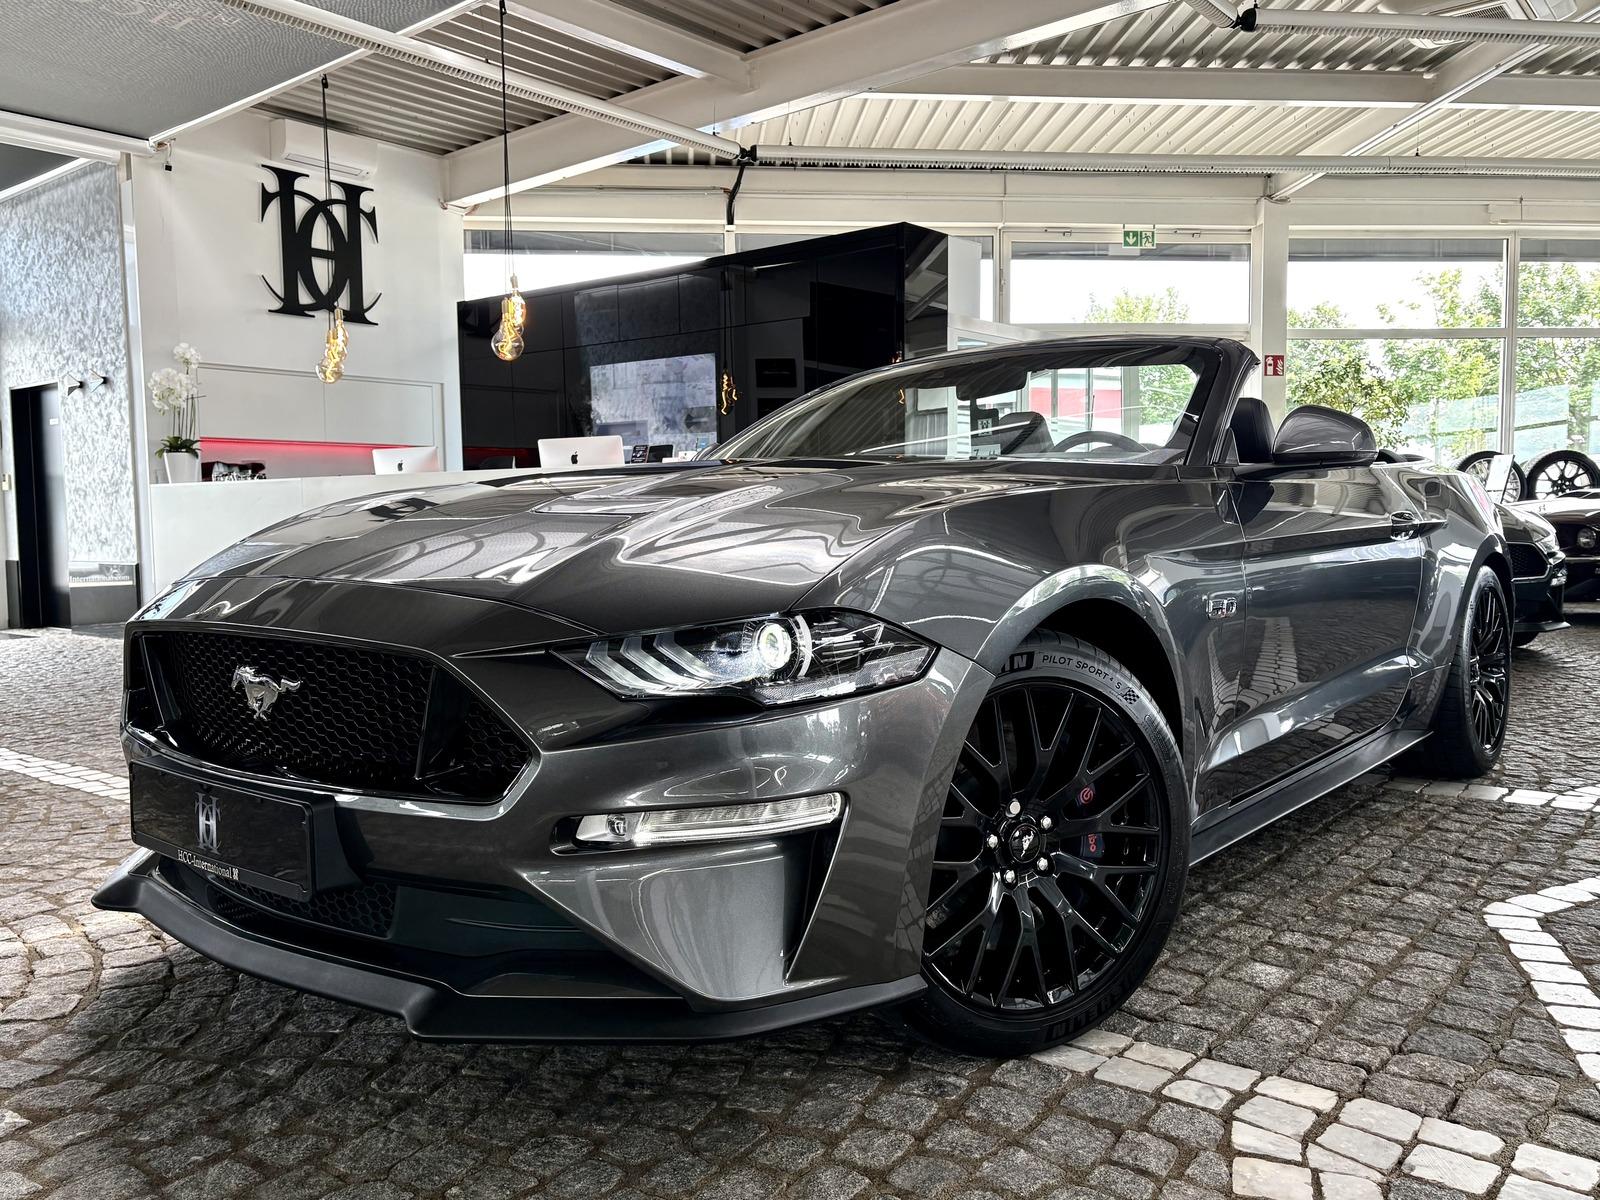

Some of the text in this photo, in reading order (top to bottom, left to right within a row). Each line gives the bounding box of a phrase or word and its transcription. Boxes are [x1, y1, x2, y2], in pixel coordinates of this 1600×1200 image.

[1041, 654, 1073, 667] PILOT
[1075, 660, 1109, 681] SPORT
[1115, 682, 1122, 690] S
[177, 849, 232, 879] HCC-International
